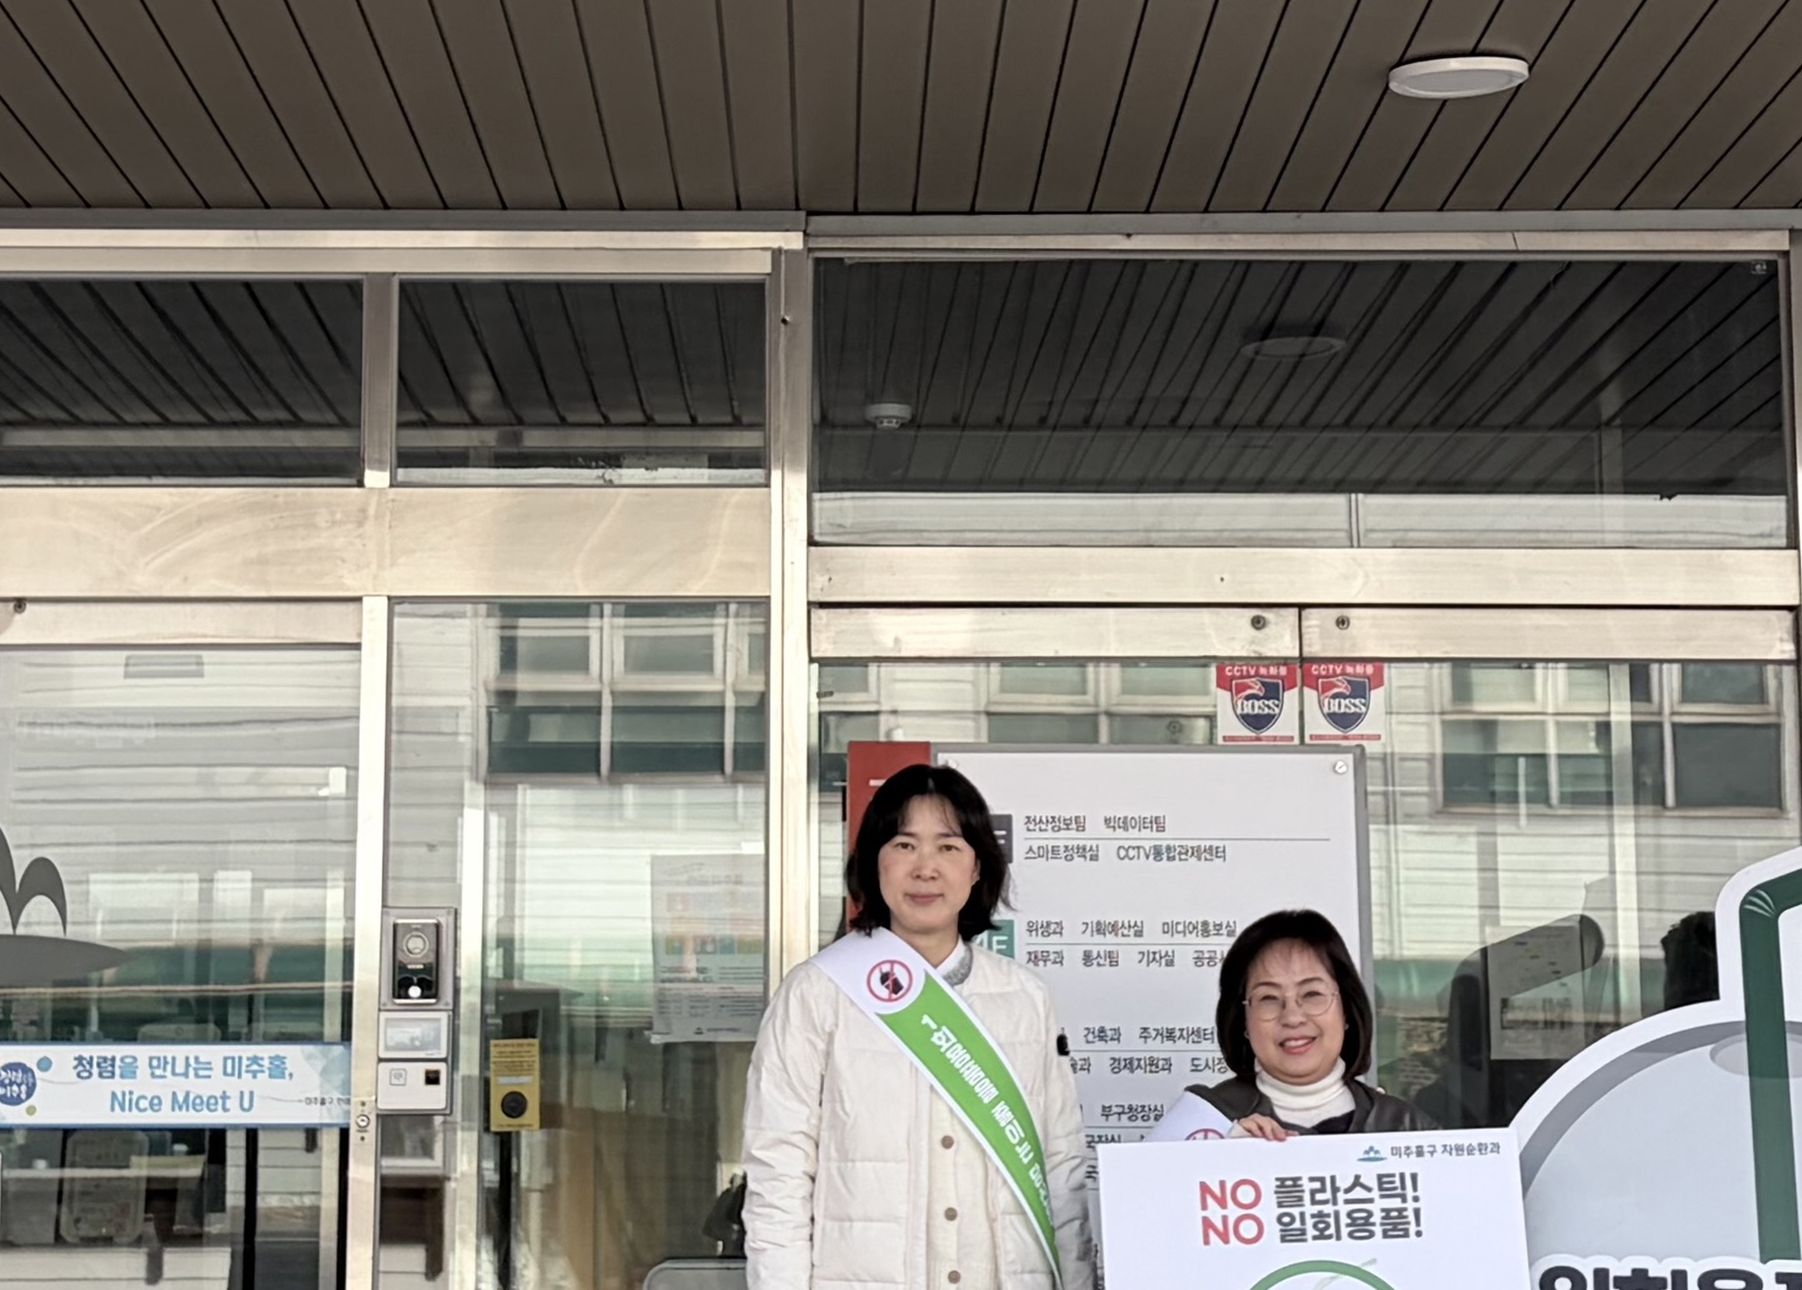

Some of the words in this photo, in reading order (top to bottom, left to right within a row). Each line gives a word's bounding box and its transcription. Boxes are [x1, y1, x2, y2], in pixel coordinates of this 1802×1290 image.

[1226, 666, 1256, 676] CCTV
[1311, 665, 1342, 675] CCTV
[1023, 814, 1087, 833] 전산정보팀
[1103, 814, 1166, 833] 빅데이터팀
[1023, 844, 1100, 862] 스마트정책실
[1116, 844, 1227, 862] CCTV통합관제센터
[1026, 919, 1064, 939] 위생과
[1081, 920, 1144, 938] 기획예산실
[1161, 919, 1237, 939] 미디어홍보실
[1026, 949, 1064, 968] 재무과
[1082, 949, 1120, 968] 통신팀
[1137, 949, 1175, 968] 기자실
[1083, 1026, 1122, 1044] 건축과
[72, 1054, 139, 1080] 청렴을
[148, 1055, 214, 1080] 만나는
[222, 1055, 293, 1081] 미추홀,
[1109, 1057, 1172, 1074] 경제지원과
[110, 1090, 163, 1112] Nice
[171, 1090, 233, 1112] Meet
[240, 1090, 255, 1112] U
[1390, 1144, 1438, 1159] 미추홀구
[1441, 1141, 1501, 1157] 자원순환과
[1199, 1179, 1262, 1211] NO
[1274, 1172, 1420, 1209] 플라스틱!
[1201, 1213, 1265, 1246] NO
[1276, 1207, 1423, 1244] 일회용품!
